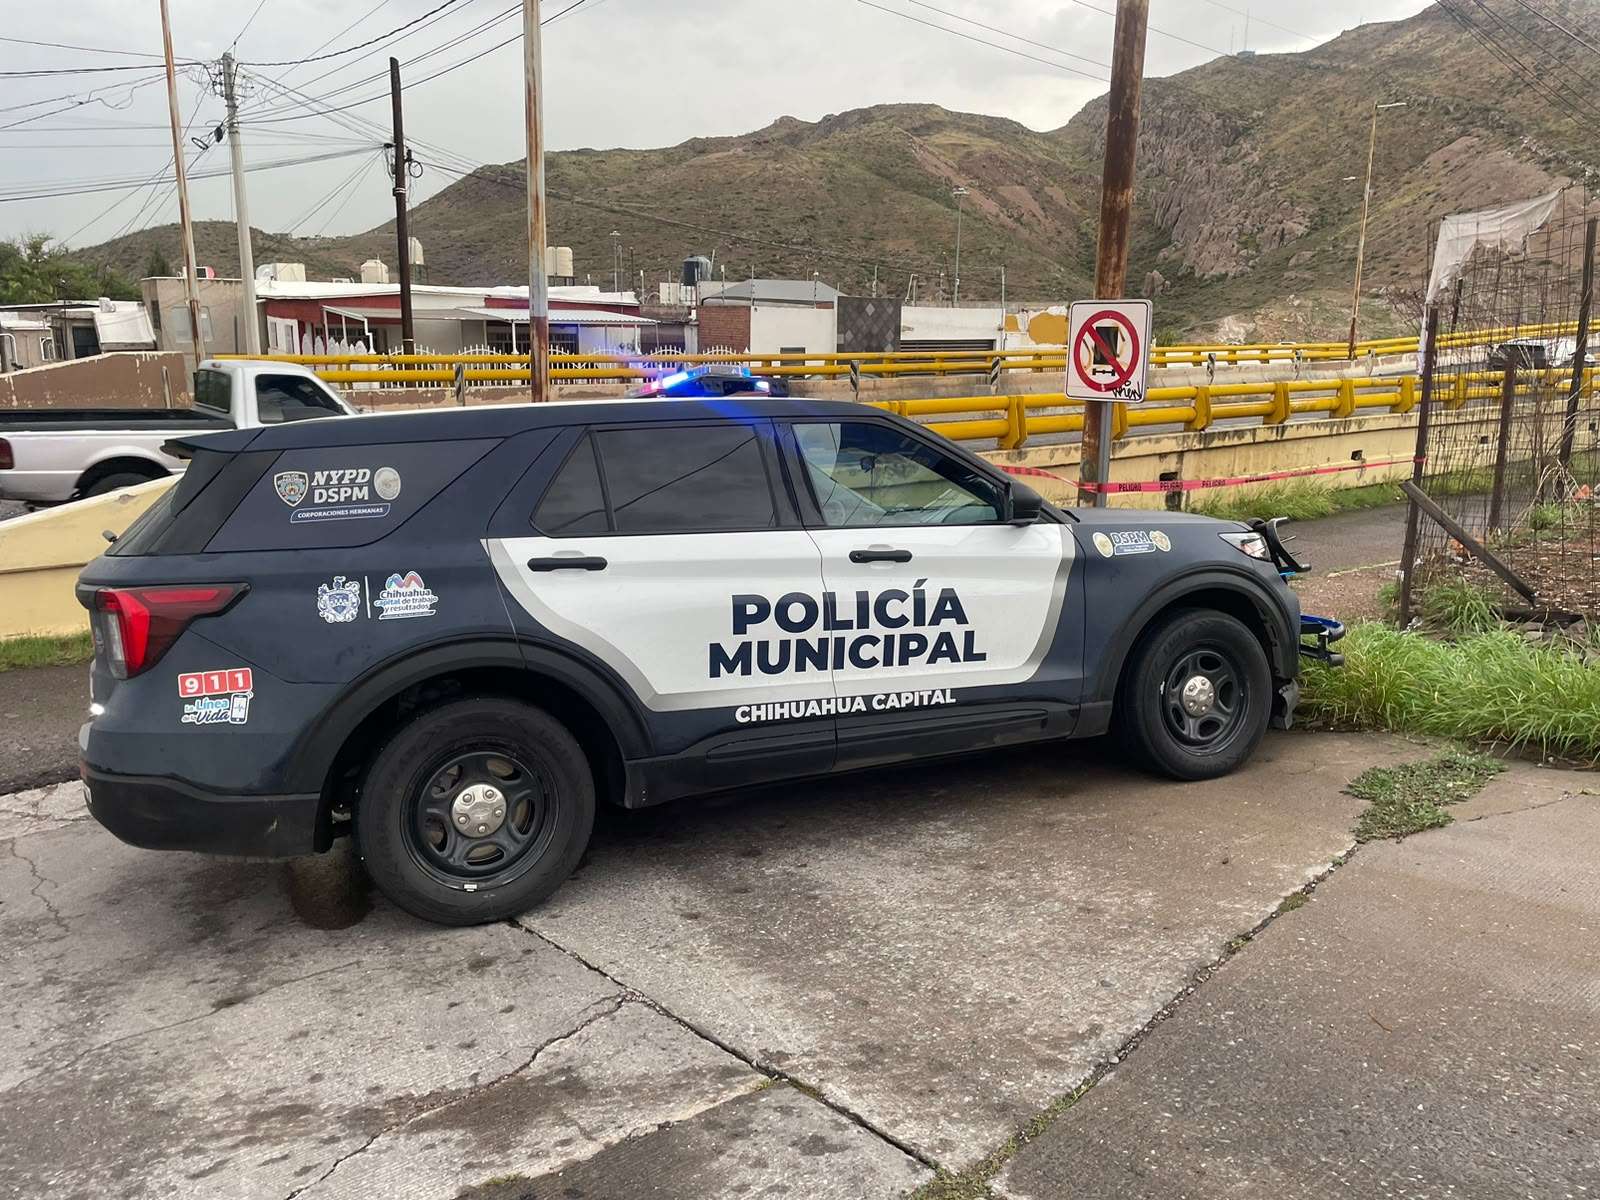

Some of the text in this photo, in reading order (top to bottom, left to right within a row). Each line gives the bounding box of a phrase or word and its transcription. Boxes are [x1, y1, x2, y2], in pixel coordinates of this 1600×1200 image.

[311, 468, 371, 486] NYPD
[1118, 482, 1142, 492] PELIGRO
[1160, 481, 1184, 491] PELIGRO
[313, 486, 369, 503] DSPM
[297, 507, 384, 519] CORPORACIONES HERMANAS
[1112, 531, 1149, 545] DSPM
[375, 599, 401, 607] capital
[411, 595, 438, 604] trabajo
[381, 589, 431, 599] Chihuahua
[731, 578, 969, 636] POLICÍA
[708, 630, 988, 679] MUNICIPAL
[185, 672, 244, 693] 911
[196, 697, 229, 711] Línea
[735, 688, 957, 723] CHIHUAHUA CAPITAL
[197, 709, 230, 723] Vida
